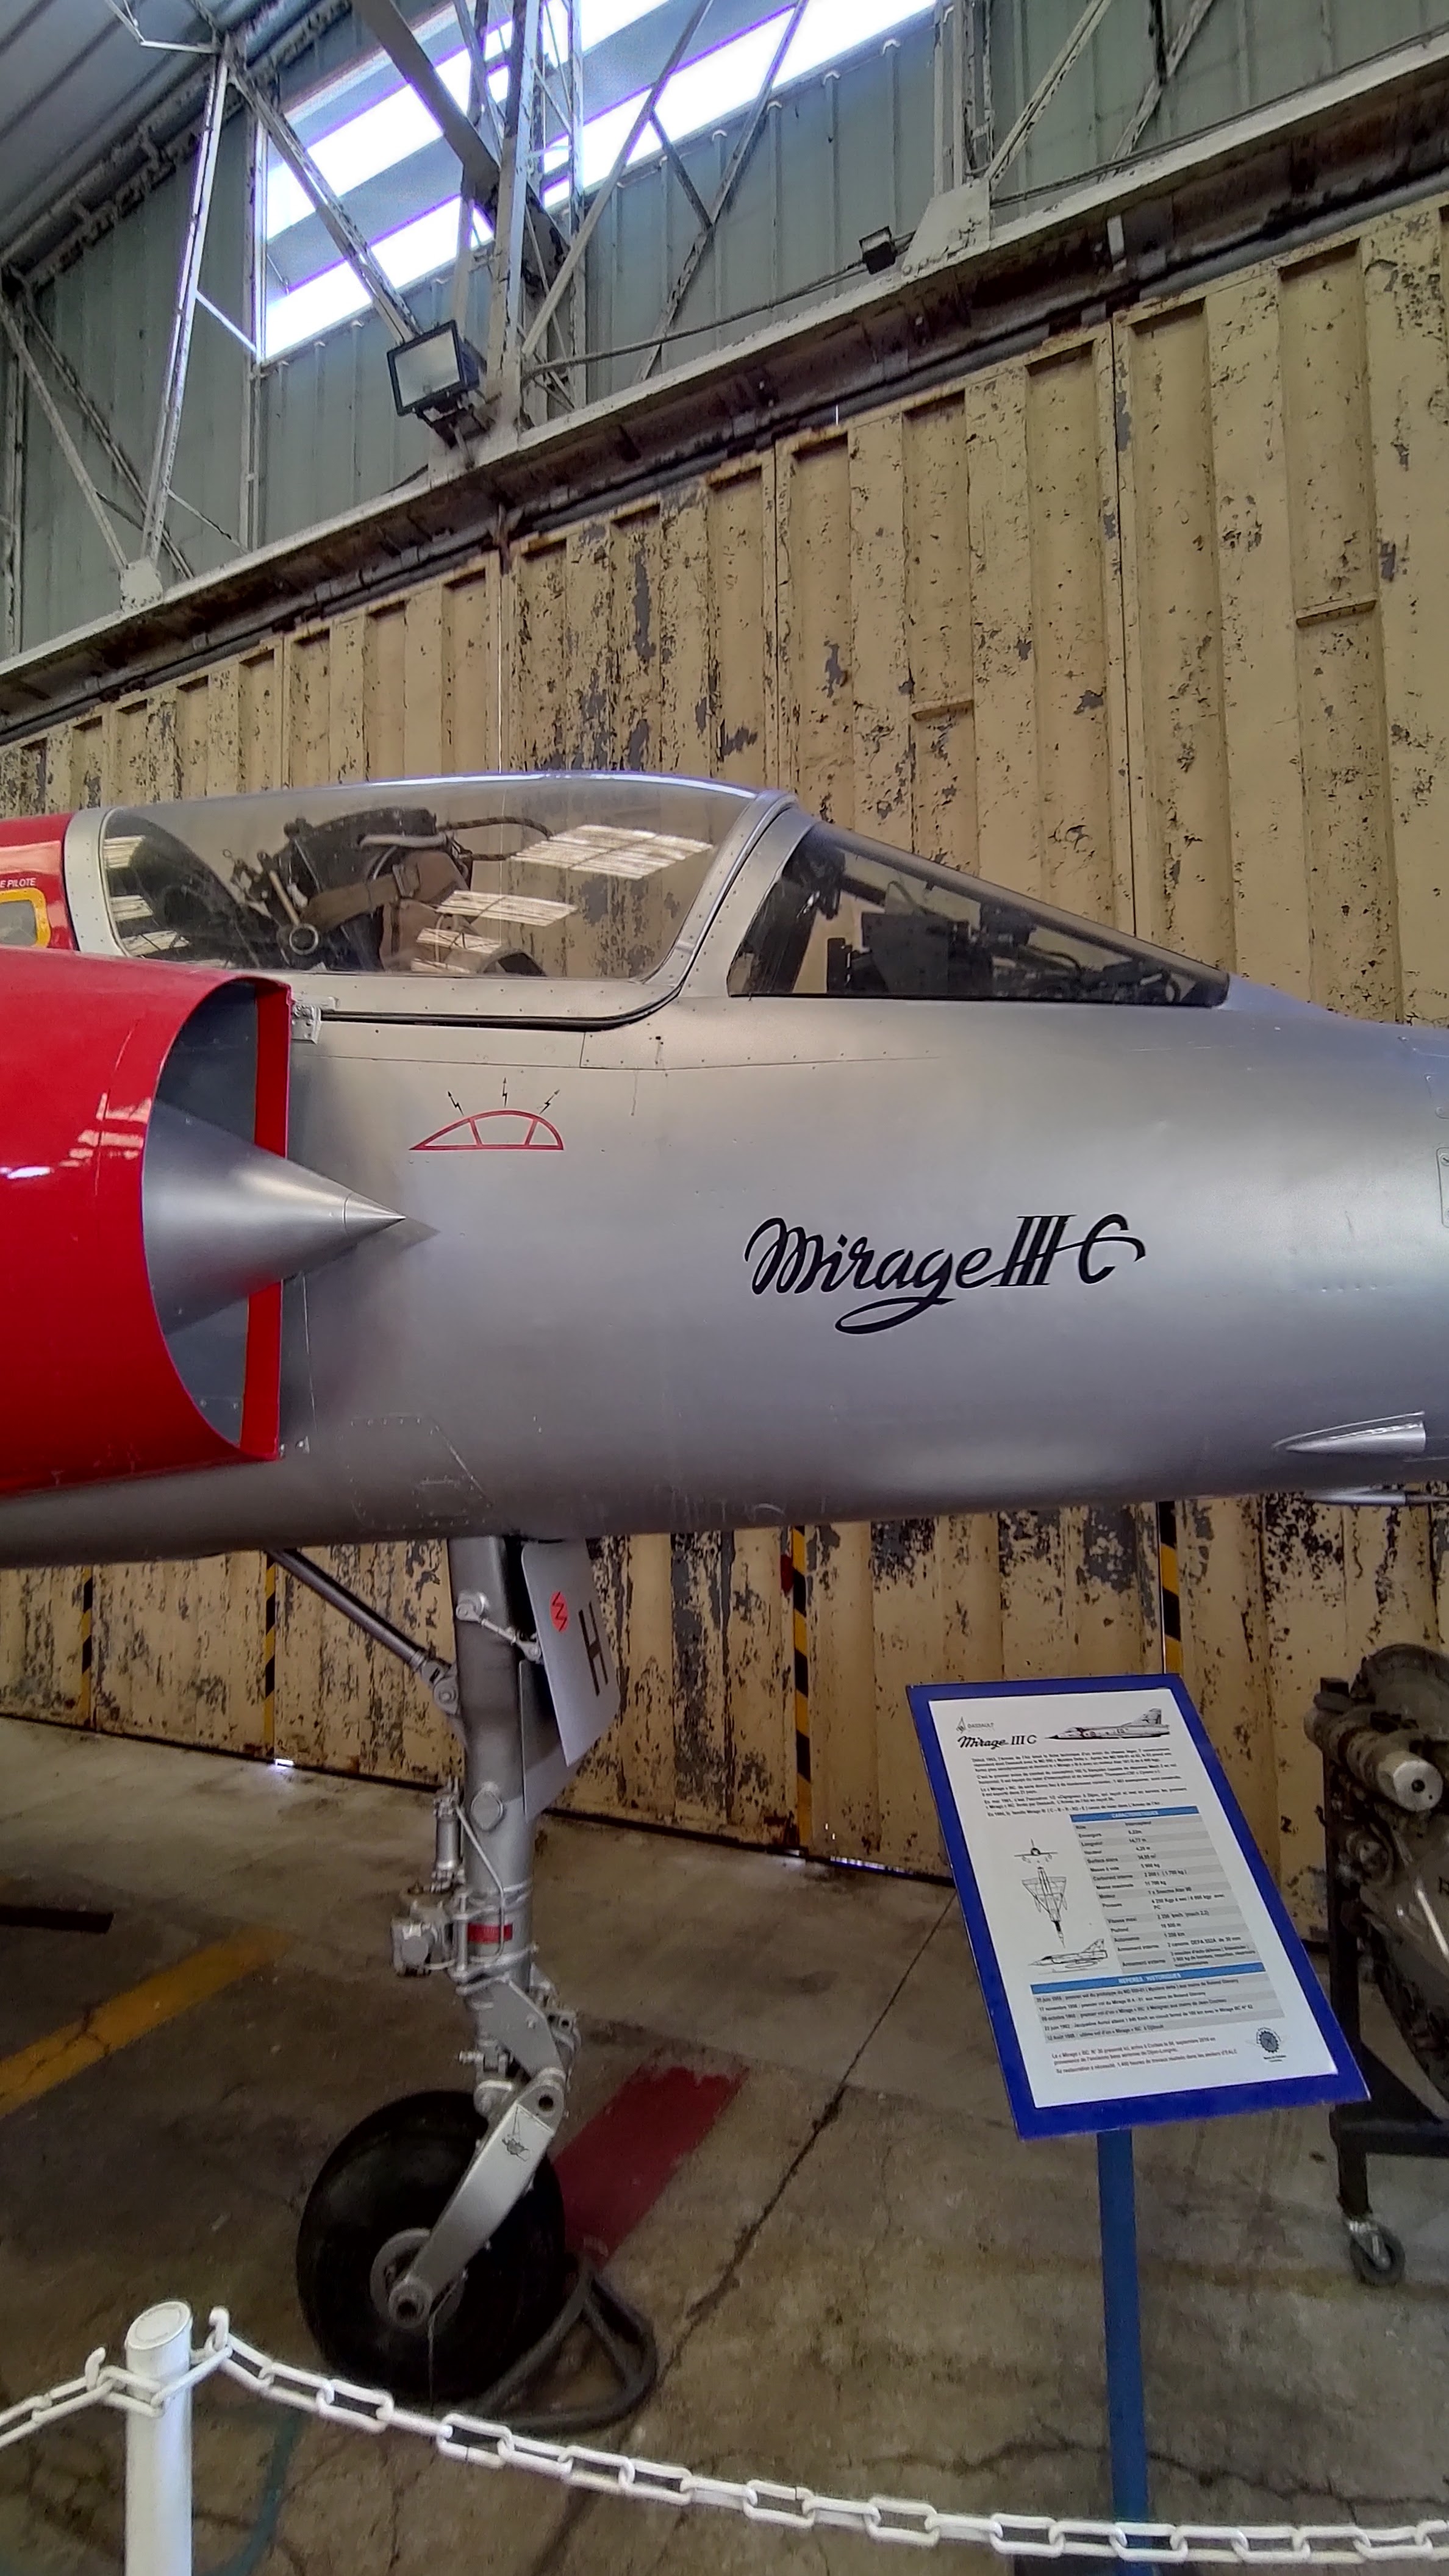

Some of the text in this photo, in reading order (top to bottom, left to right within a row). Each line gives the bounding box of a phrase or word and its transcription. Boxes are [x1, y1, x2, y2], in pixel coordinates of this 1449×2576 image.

[7, 878, 37, 887] PILOTE
[744, 1217, 1000, 1334] Mirage
[957, 1736, 1009, 1750] Mirage
